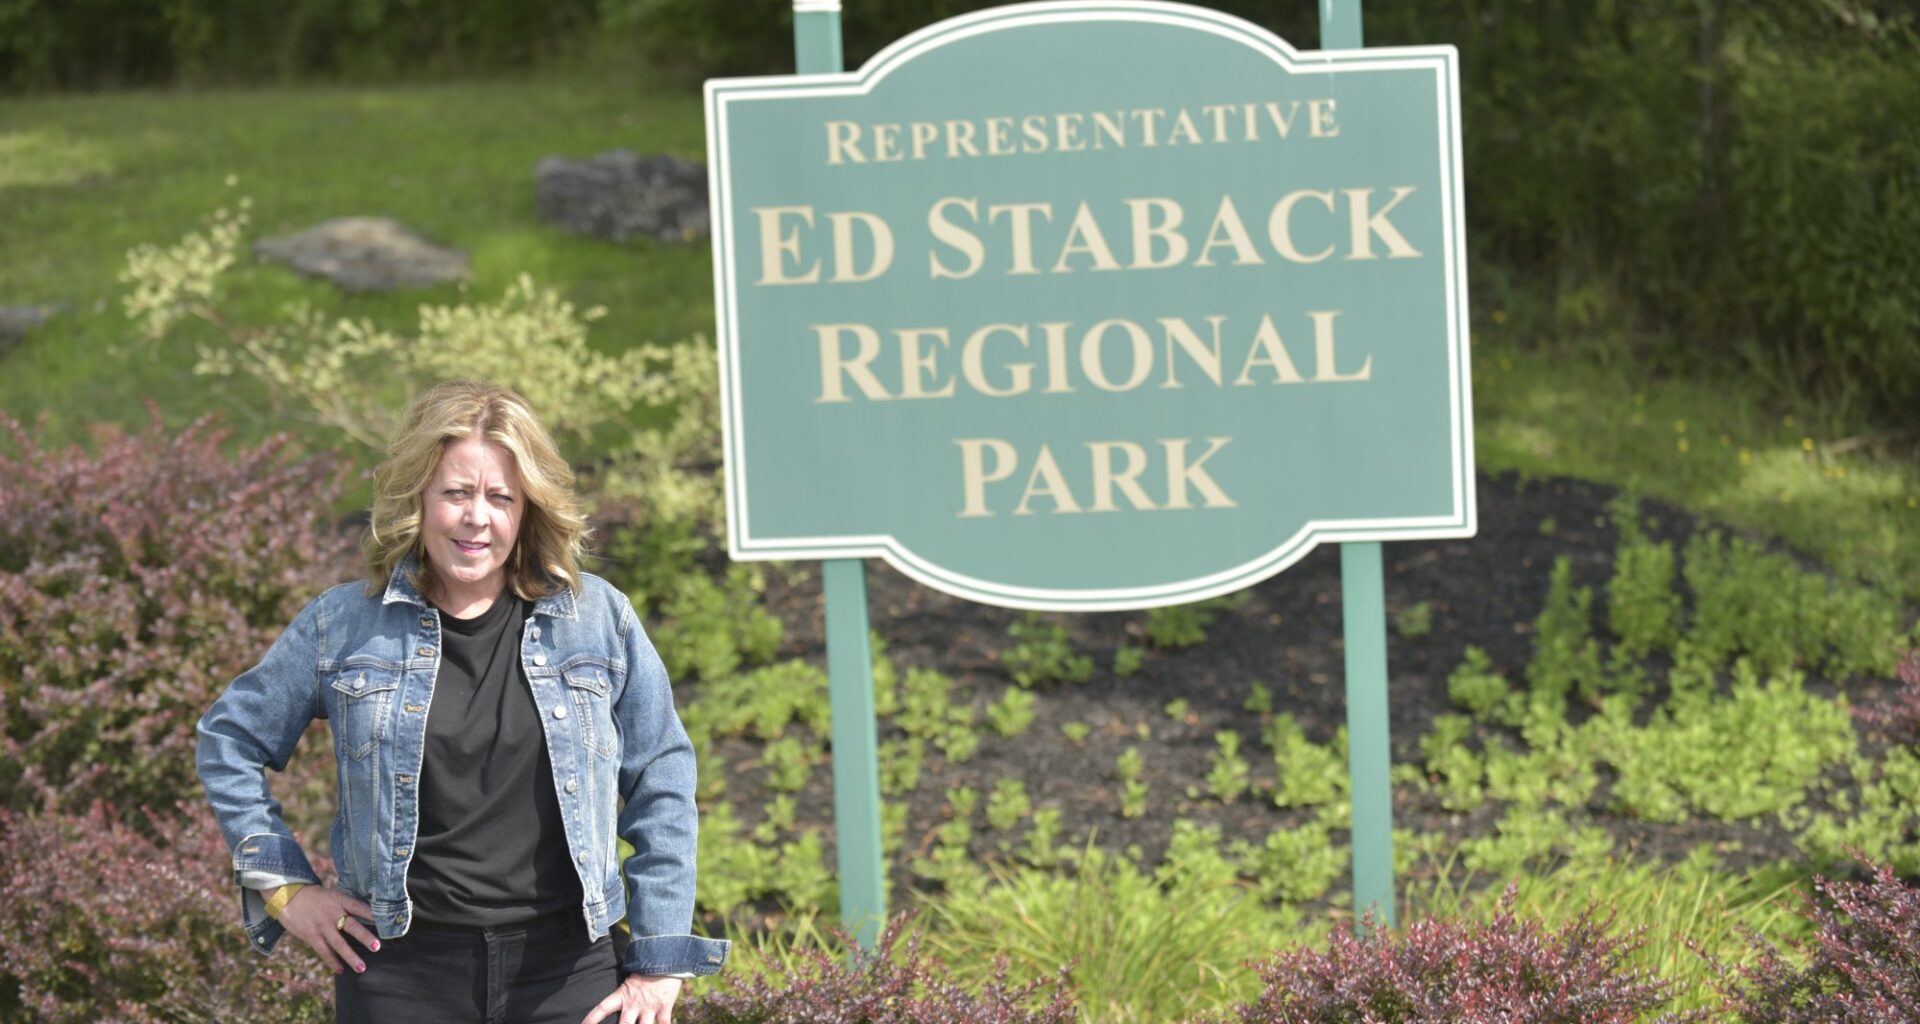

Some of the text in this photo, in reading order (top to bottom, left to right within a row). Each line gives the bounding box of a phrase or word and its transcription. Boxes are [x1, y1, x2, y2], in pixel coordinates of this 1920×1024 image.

[825, 99, 1341, 166] REPRESENTATIVE
[751, 186, 1422, 287] ED STABACK
[810, 310, 1373, 404] REGIONAL
[955, 436, 1238, 519] PARK
